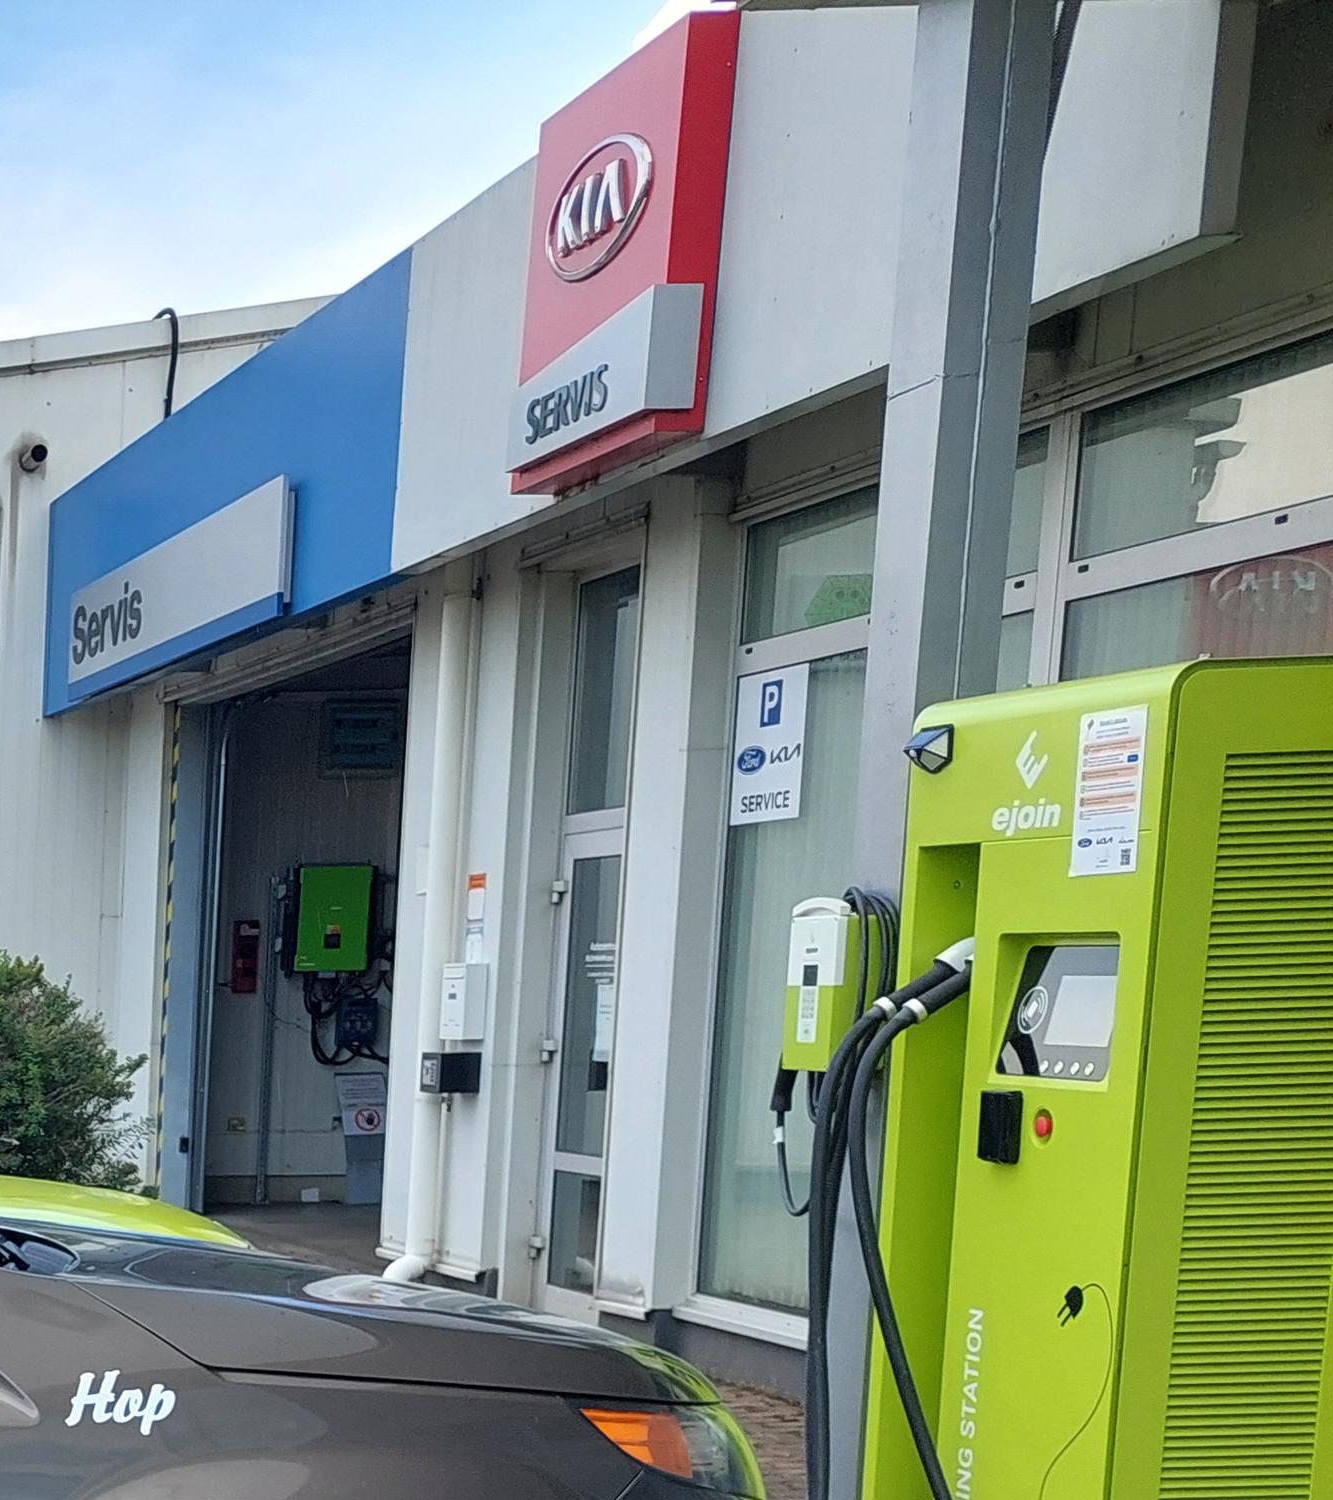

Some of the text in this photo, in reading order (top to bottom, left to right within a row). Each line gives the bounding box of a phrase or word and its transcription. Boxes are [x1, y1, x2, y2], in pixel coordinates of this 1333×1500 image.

[556, 159, 629, 258] KIA
[525, 364, 609, 444] SERVIS
[72, 581, 142, 664] Servis
[763, 685, 779, 723] P
[740, 790, 790, 813] SERVICE
[992, 797, 1061, 836] ejoin
[64, 1370, 176, 1436] Hop
[960, 1308, 984, 1440] STATION
